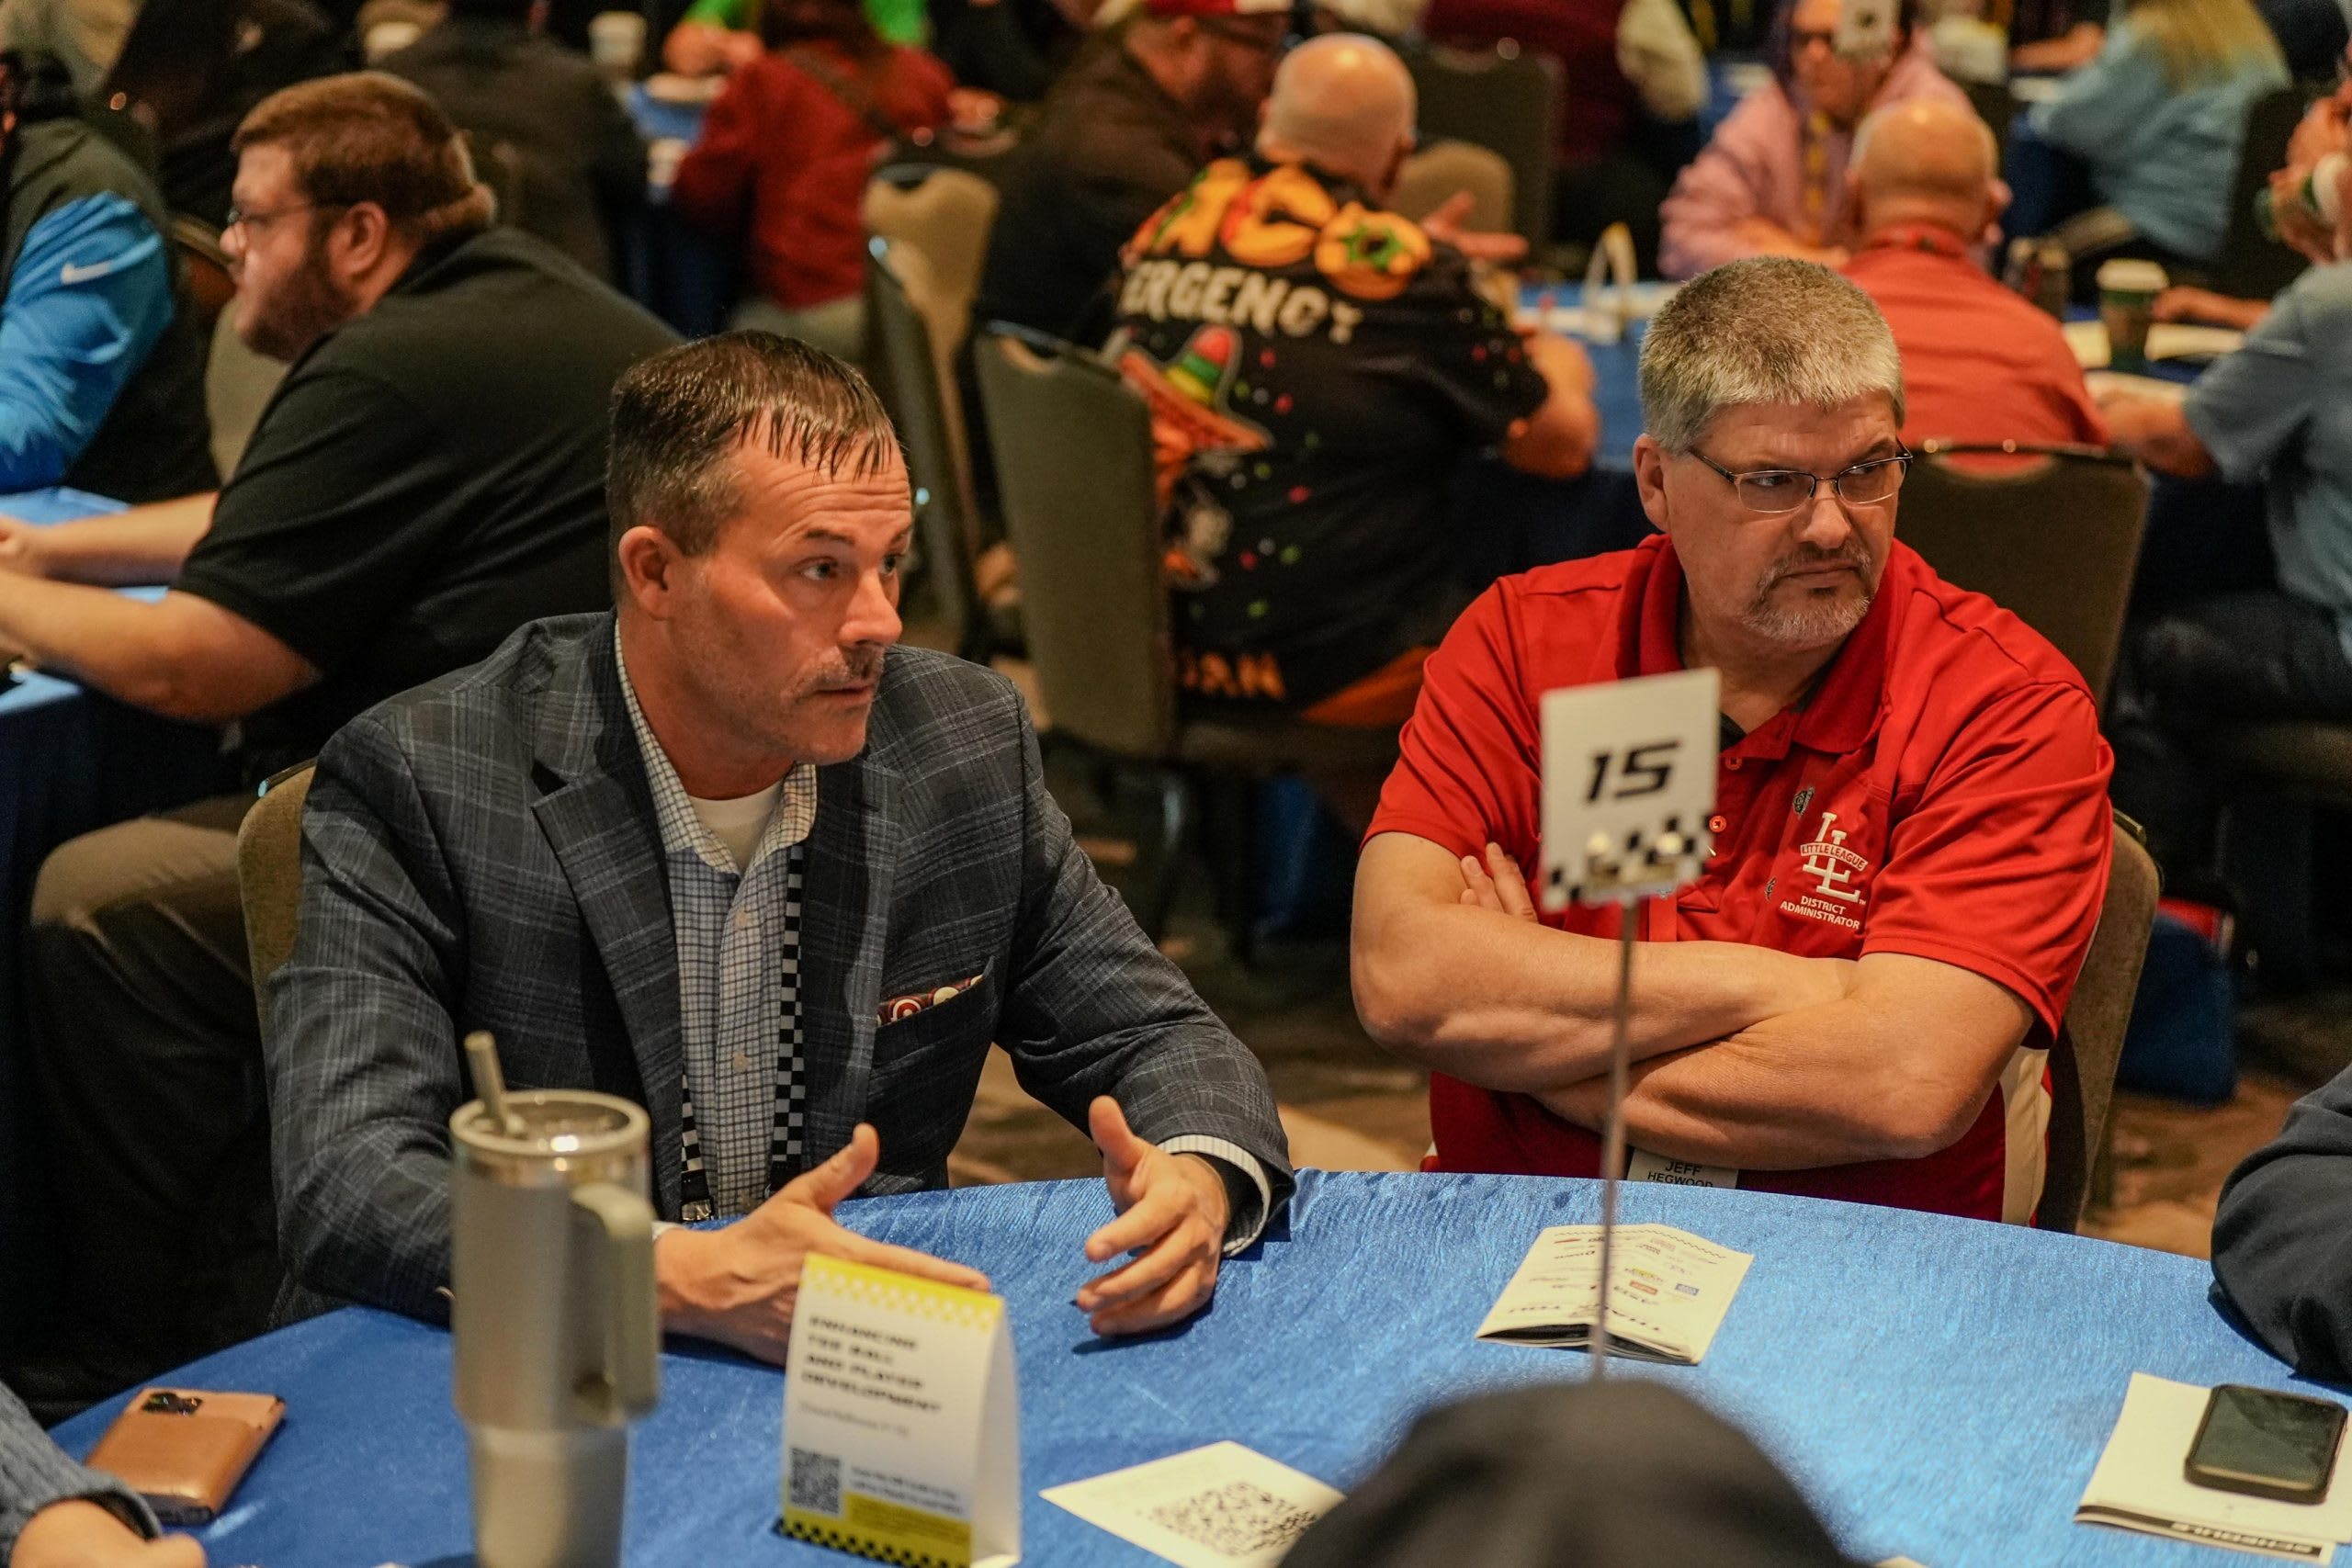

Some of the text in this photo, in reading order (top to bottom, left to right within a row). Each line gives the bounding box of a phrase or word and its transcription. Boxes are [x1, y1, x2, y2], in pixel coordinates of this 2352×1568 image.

[1586, 739, 1682, 806] 15
[1802, 843, 1866, 870] LITTLE LEAGUE
[1780, 900, 1860, 931] ADMINISTRATOR
[1801, 895, 1847, 915] DISTRICT
[1646, 1171, 1714, 1188] HEGWOOD
[1665, 1161, 1703, 1177] JEFF
